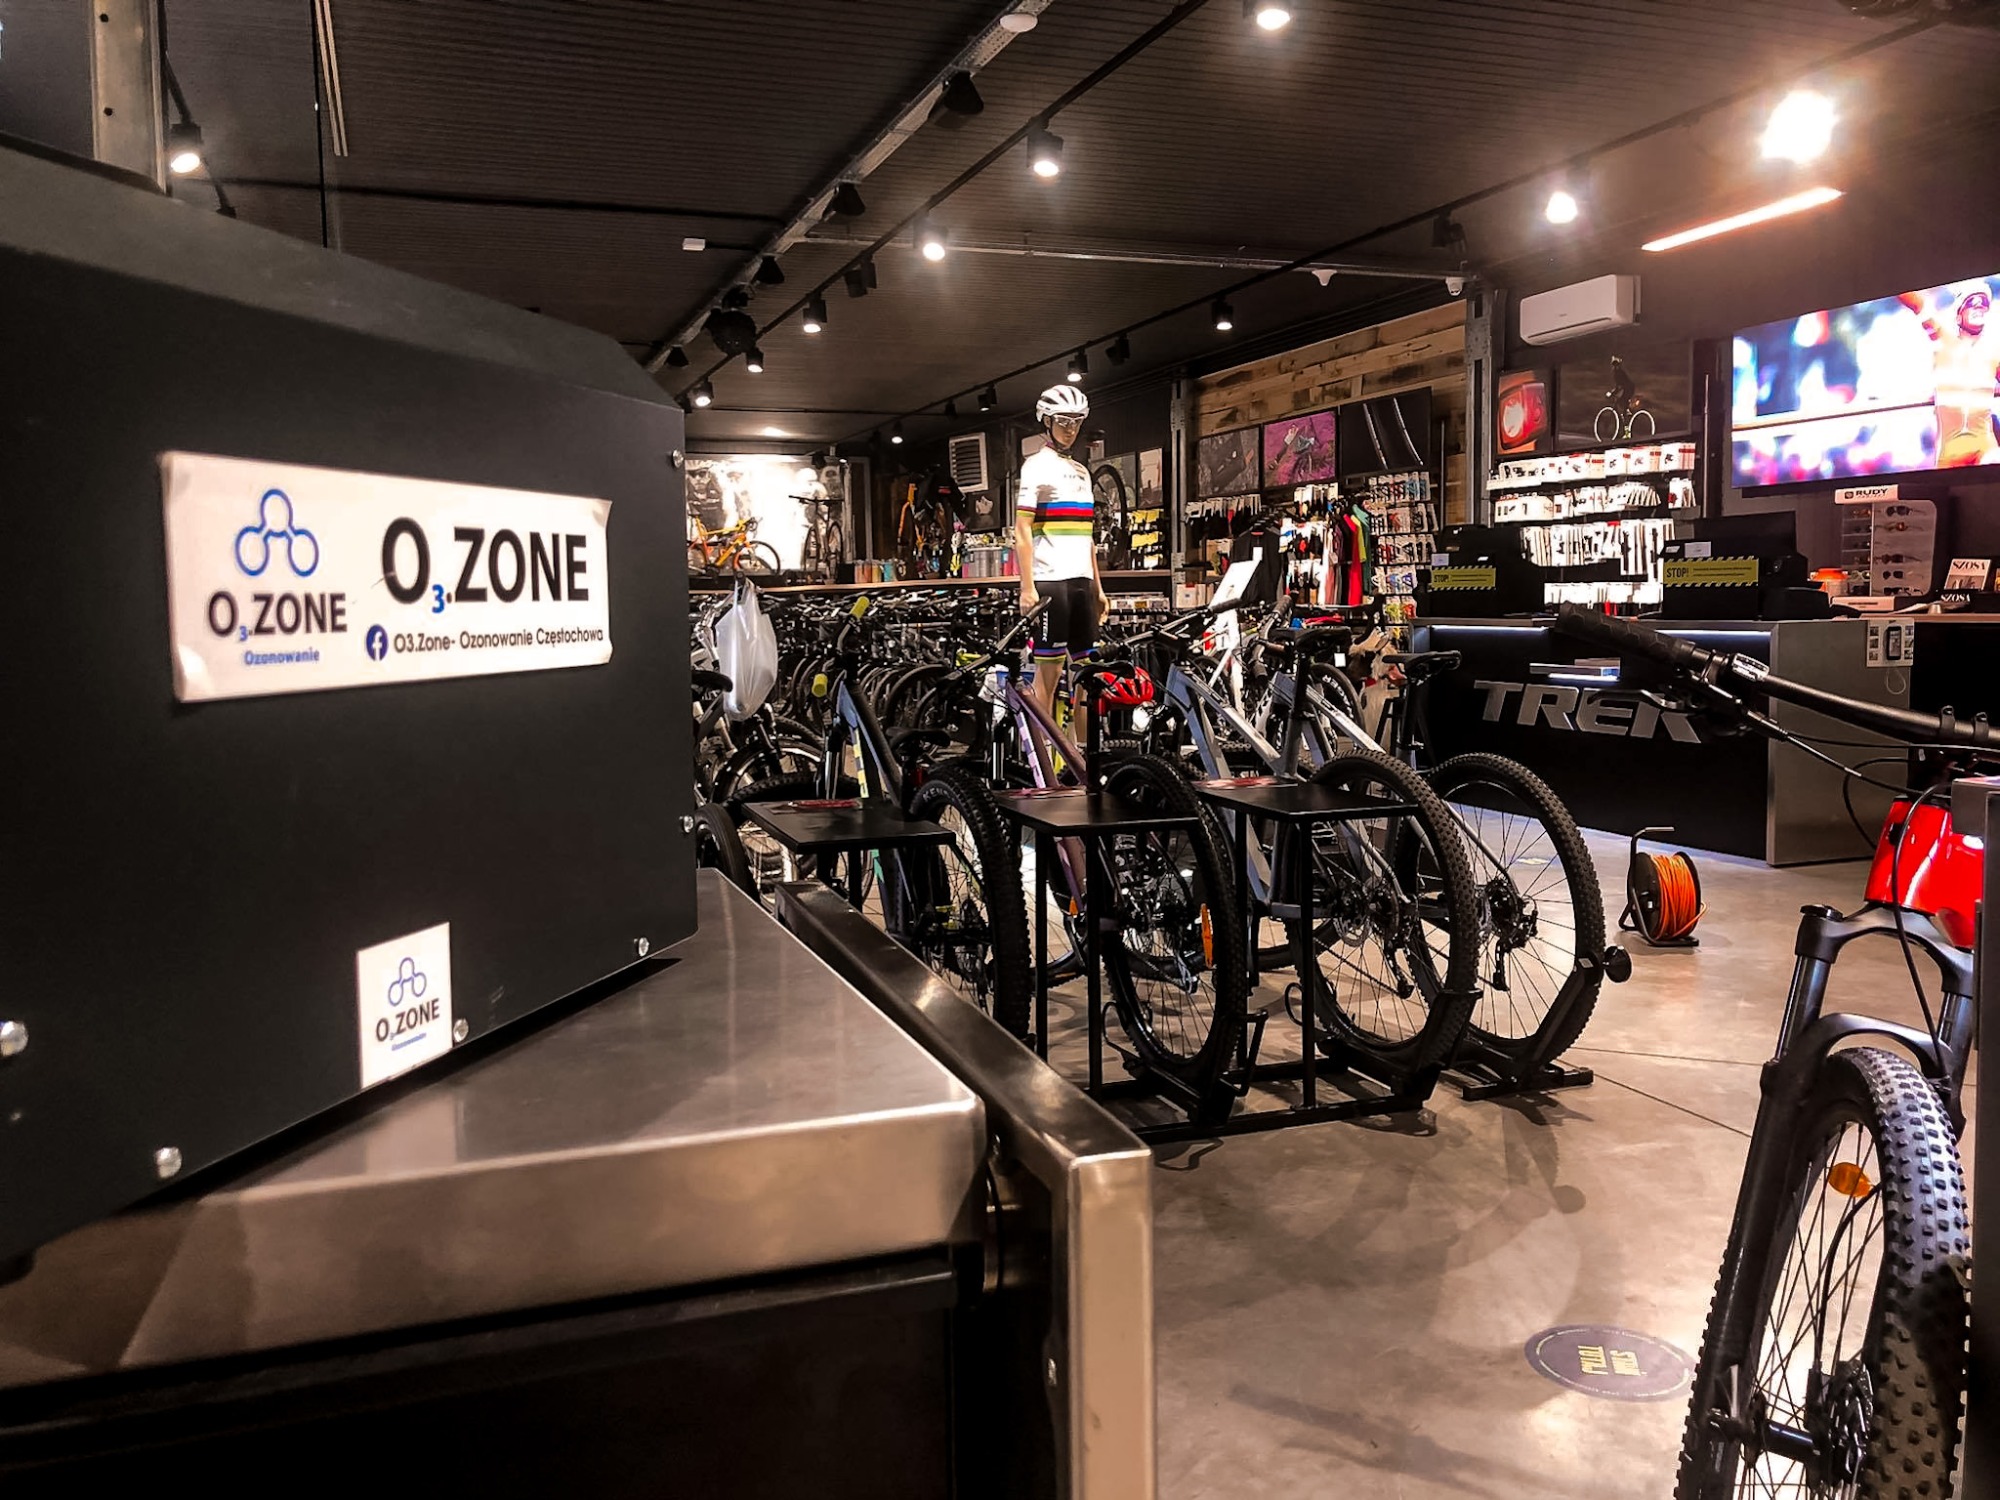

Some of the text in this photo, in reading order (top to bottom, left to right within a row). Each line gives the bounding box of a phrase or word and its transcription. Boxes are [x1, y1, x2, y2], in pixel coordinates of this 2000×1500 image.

[1856, 488, 1888, 496] RUDY
[459, 629, 533, 650] Ozonowanie
[535, 626, 604, 648] Częstochowa
[244, 647, 320, 665] Ozonowanie
[1474, 680, 1702, 744] TREK
